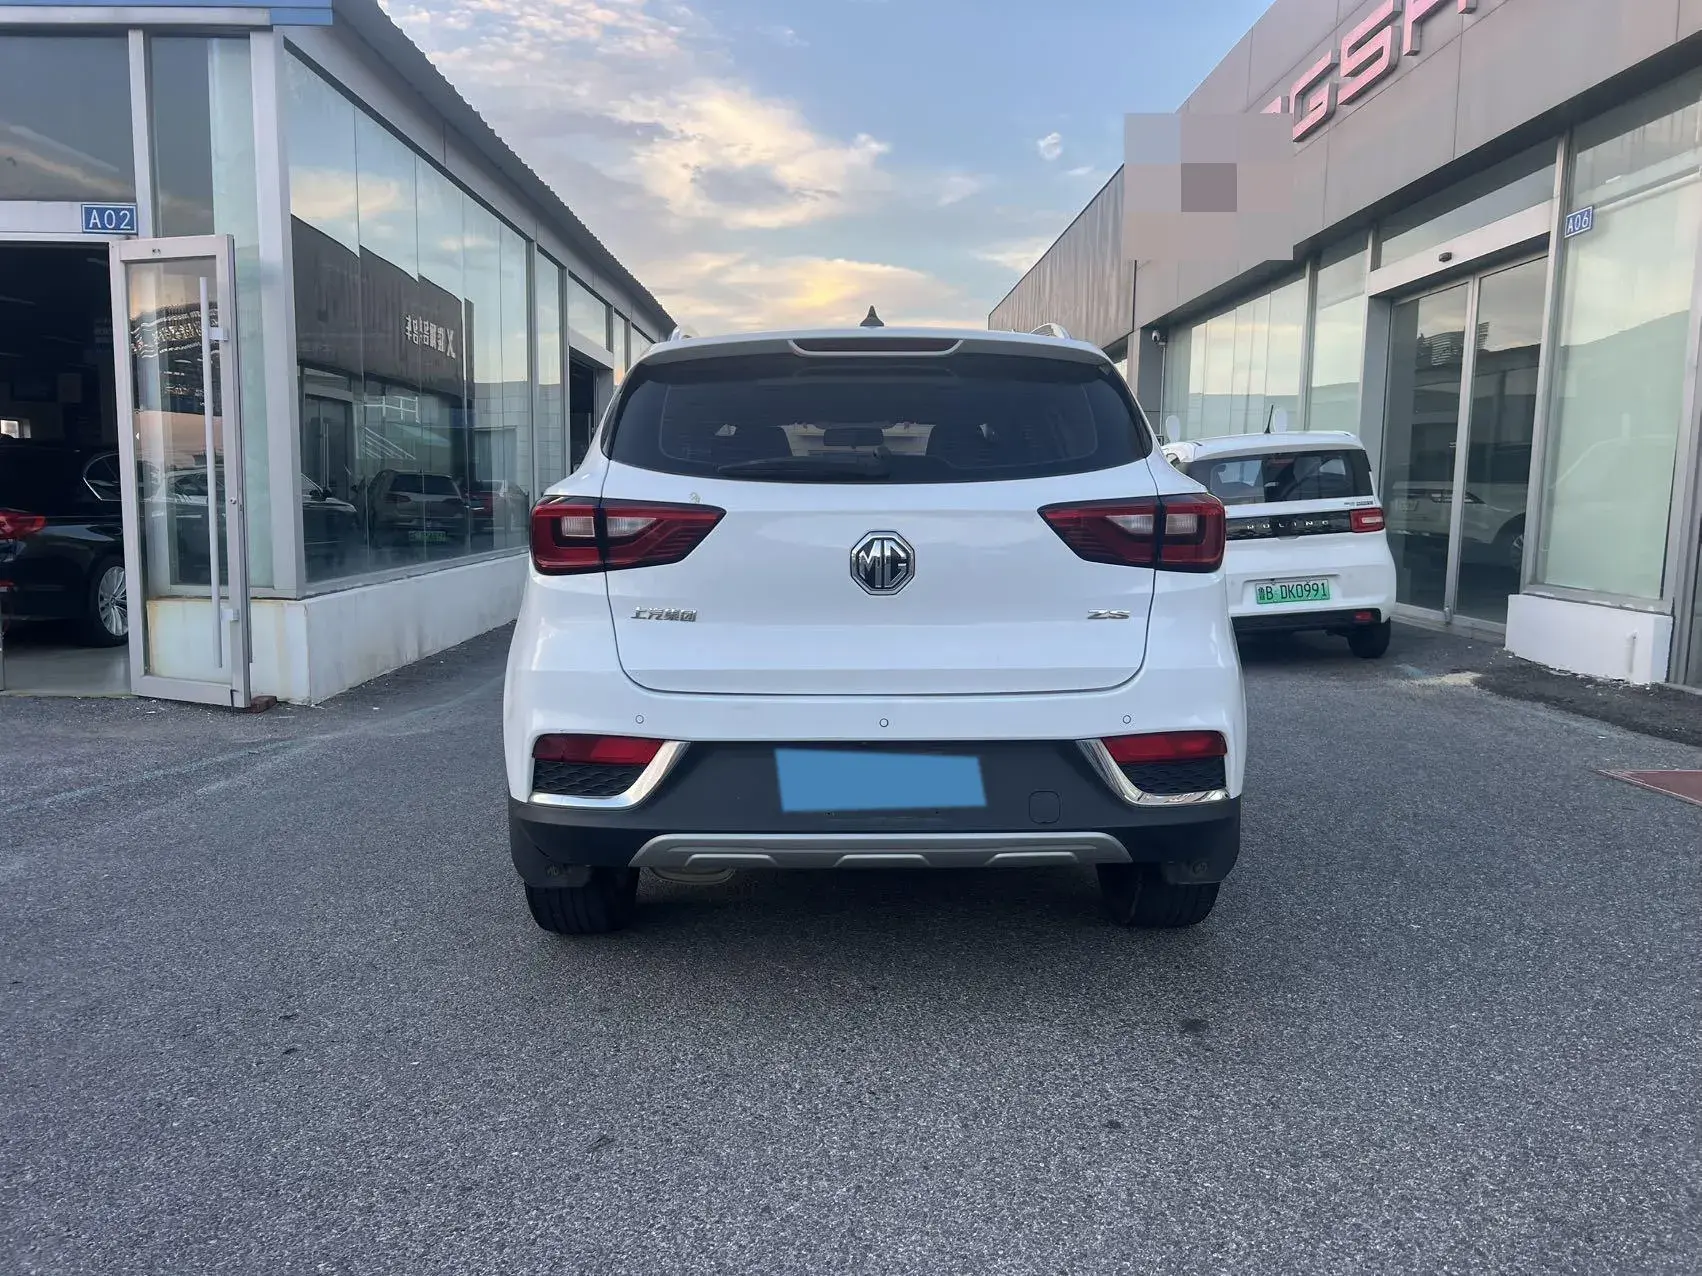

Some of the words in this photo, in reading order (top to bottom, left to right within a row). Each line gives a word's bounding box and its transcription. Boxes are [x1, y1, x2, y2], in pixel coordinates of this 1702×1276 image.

[1260, 0, 1470, 142] GS
[88, 208, 132, 229] A02
[1566, 210, 1590, 234] A06
[857, 538, 908, 589] MG
[631, 606, 697, 622] 上汽集团
[1087, 608, 1131, 620] ZS
